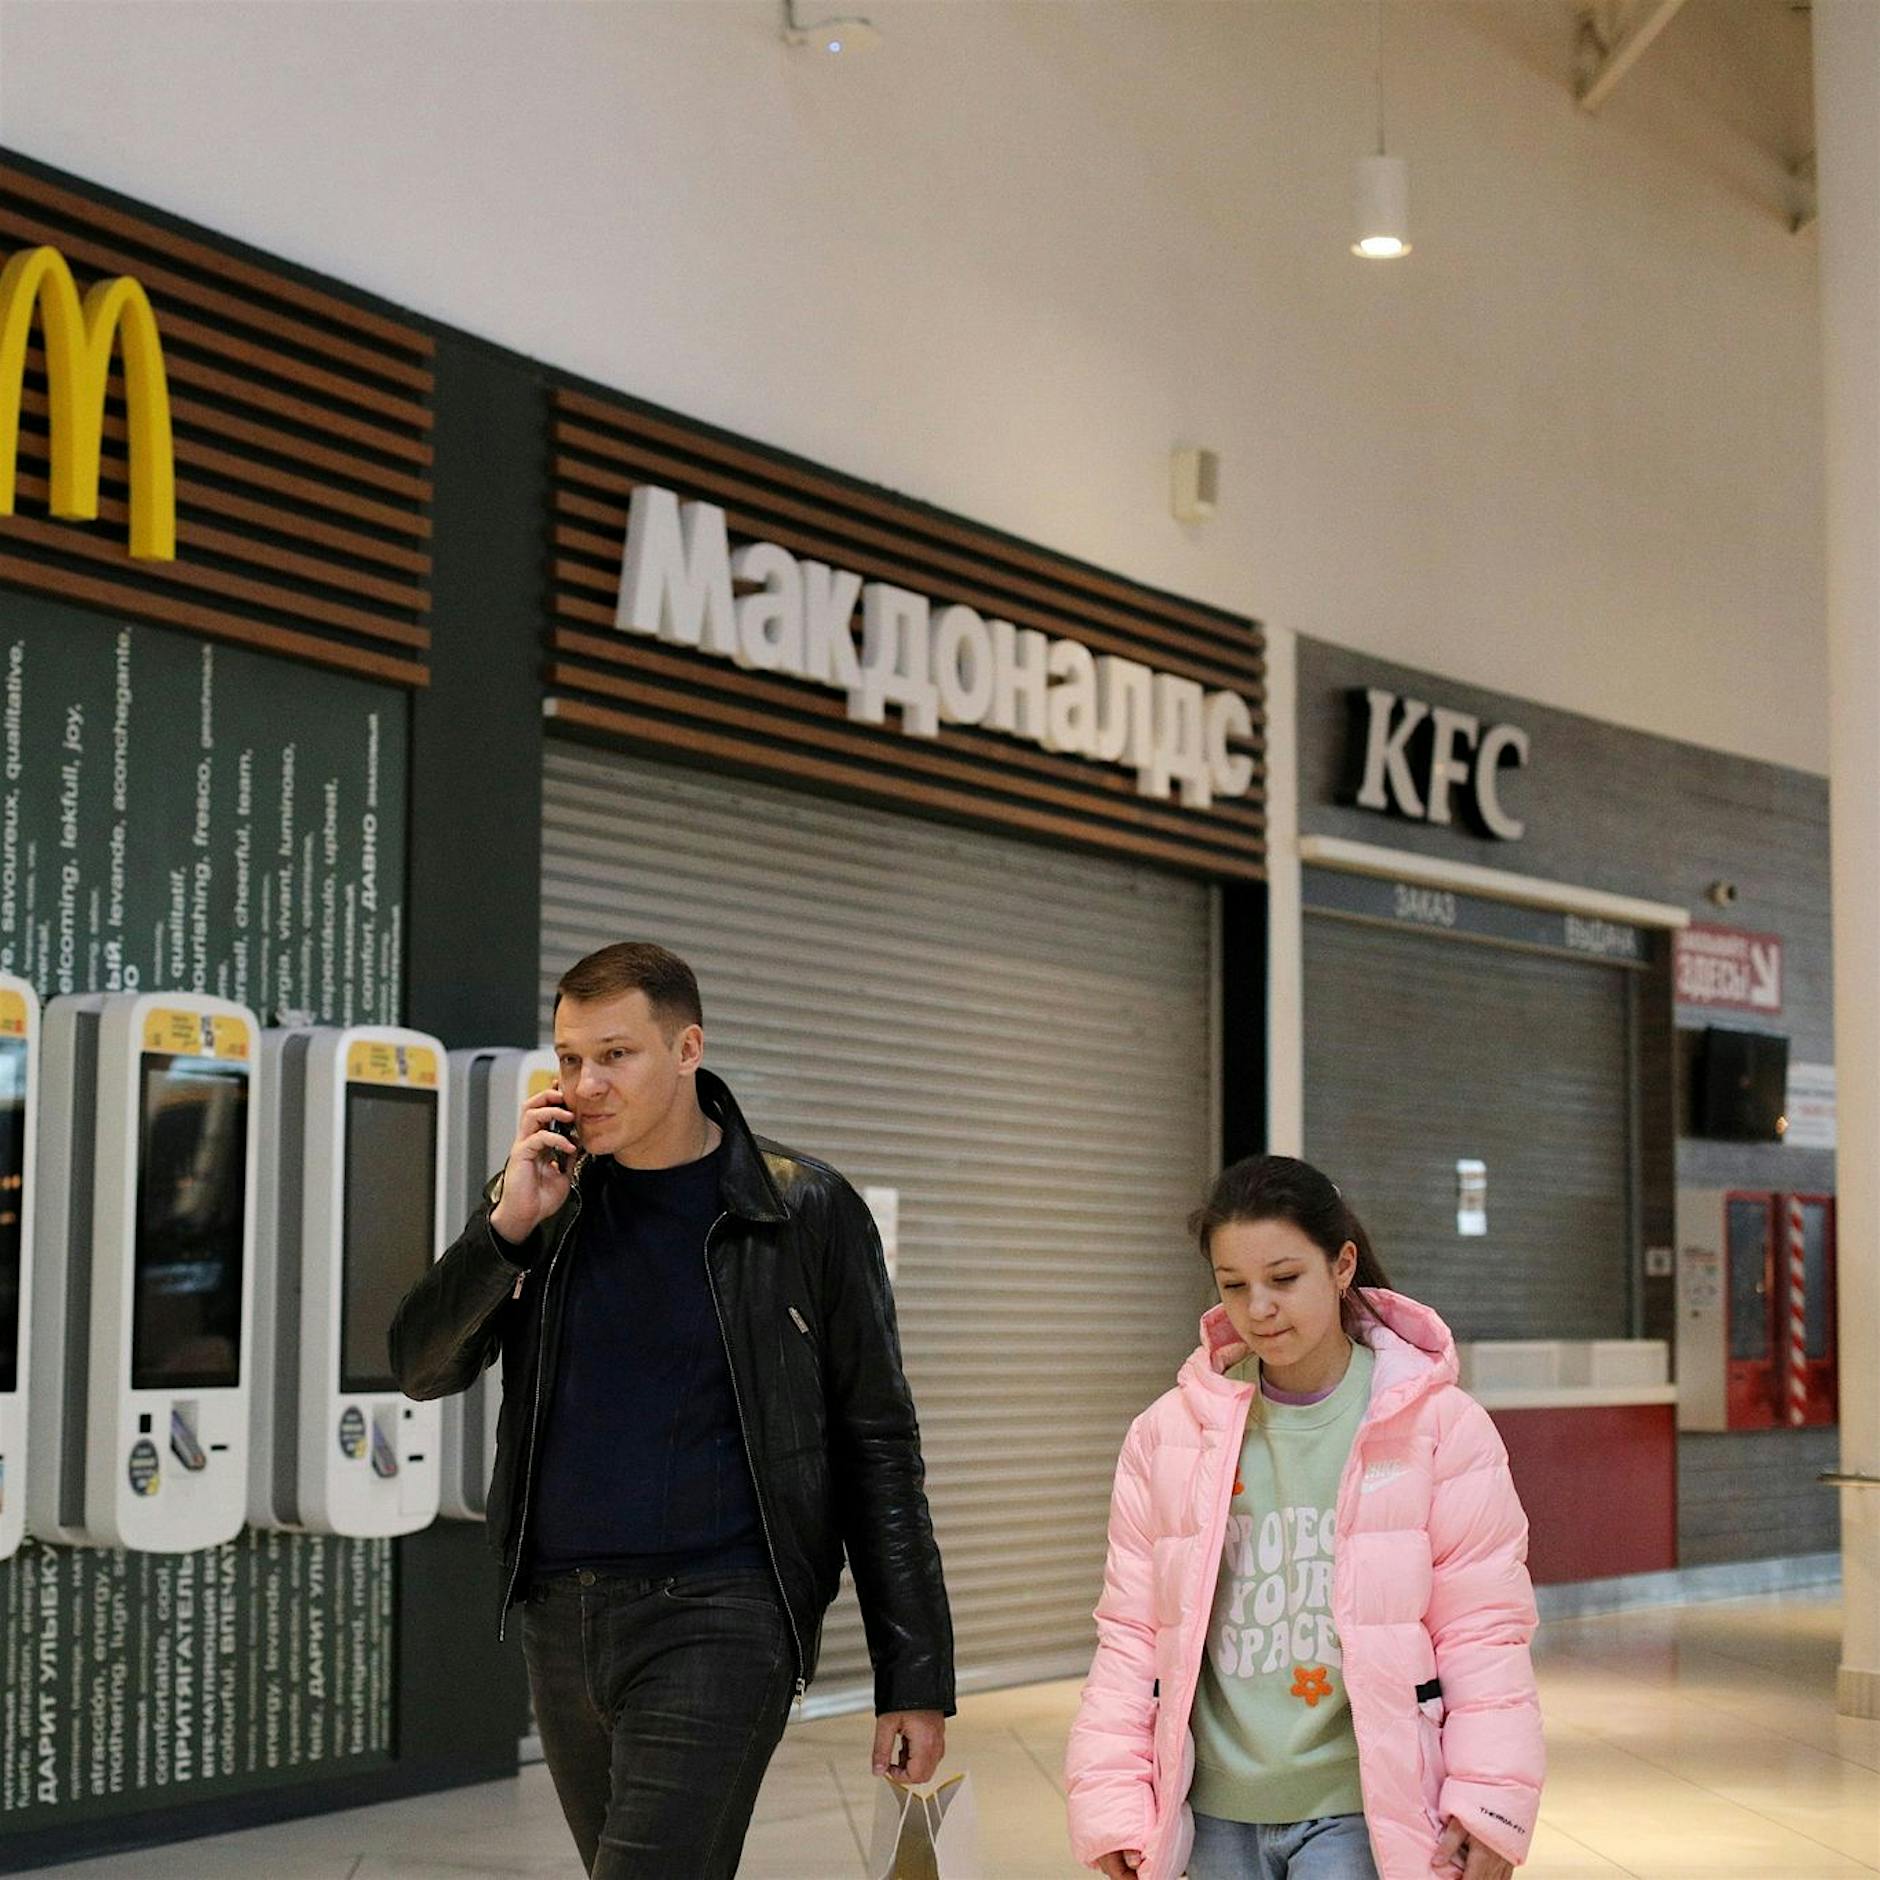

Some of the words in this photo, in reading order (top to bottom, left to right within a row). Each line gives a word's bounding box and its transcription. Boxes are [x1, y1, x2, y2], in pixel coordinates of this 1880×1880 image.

[616, 484, 1255, 809] Макдоналдс
[4, 640, 25, 780] qualitative,
[237, 749, 254, 815] team,
[1356, 686, 1530, 841] KFC
[360, 812, 378, 912] ДАВНО
[38, 1543, 60, 1685] УЛЫБКУ
[92, 1566, 112, 1663] energy,
[154, 1559, 173, 1622] cool,
[1228, 1560, 1336, 1627] YOUR
[308, 1605, 326, 1698] ДАРИТ
[1218, 1611, 1343, 1678] SPACE
[37, 1692, 59, 1805] ДАРИТ
[152, 1627, 173, 1786] comfortable,
